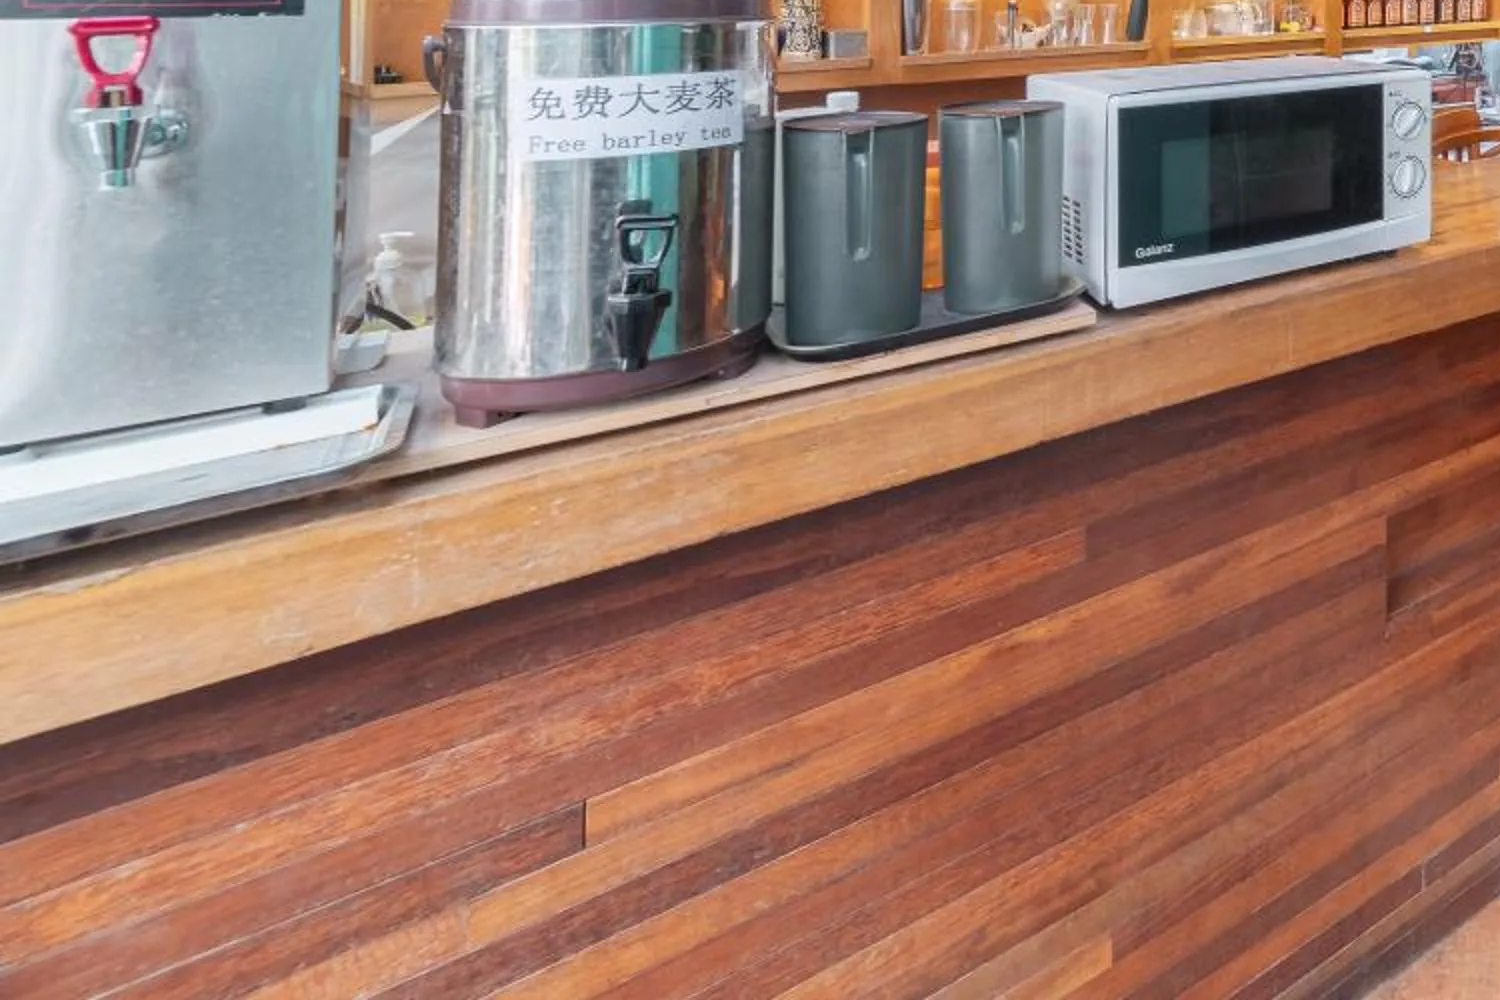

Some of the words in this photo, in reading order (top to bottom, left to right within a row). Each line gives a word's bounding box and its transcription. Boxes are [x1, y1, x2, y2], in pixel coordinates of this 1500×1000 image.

[527, 76, 737, 122] 免费大麦茶
[529, 135, 586, 154] Free
[602, 130, 688, 151] barley
[701, 127, 732, 141] tea
[1136, 243, 1173, 258] Galanz
